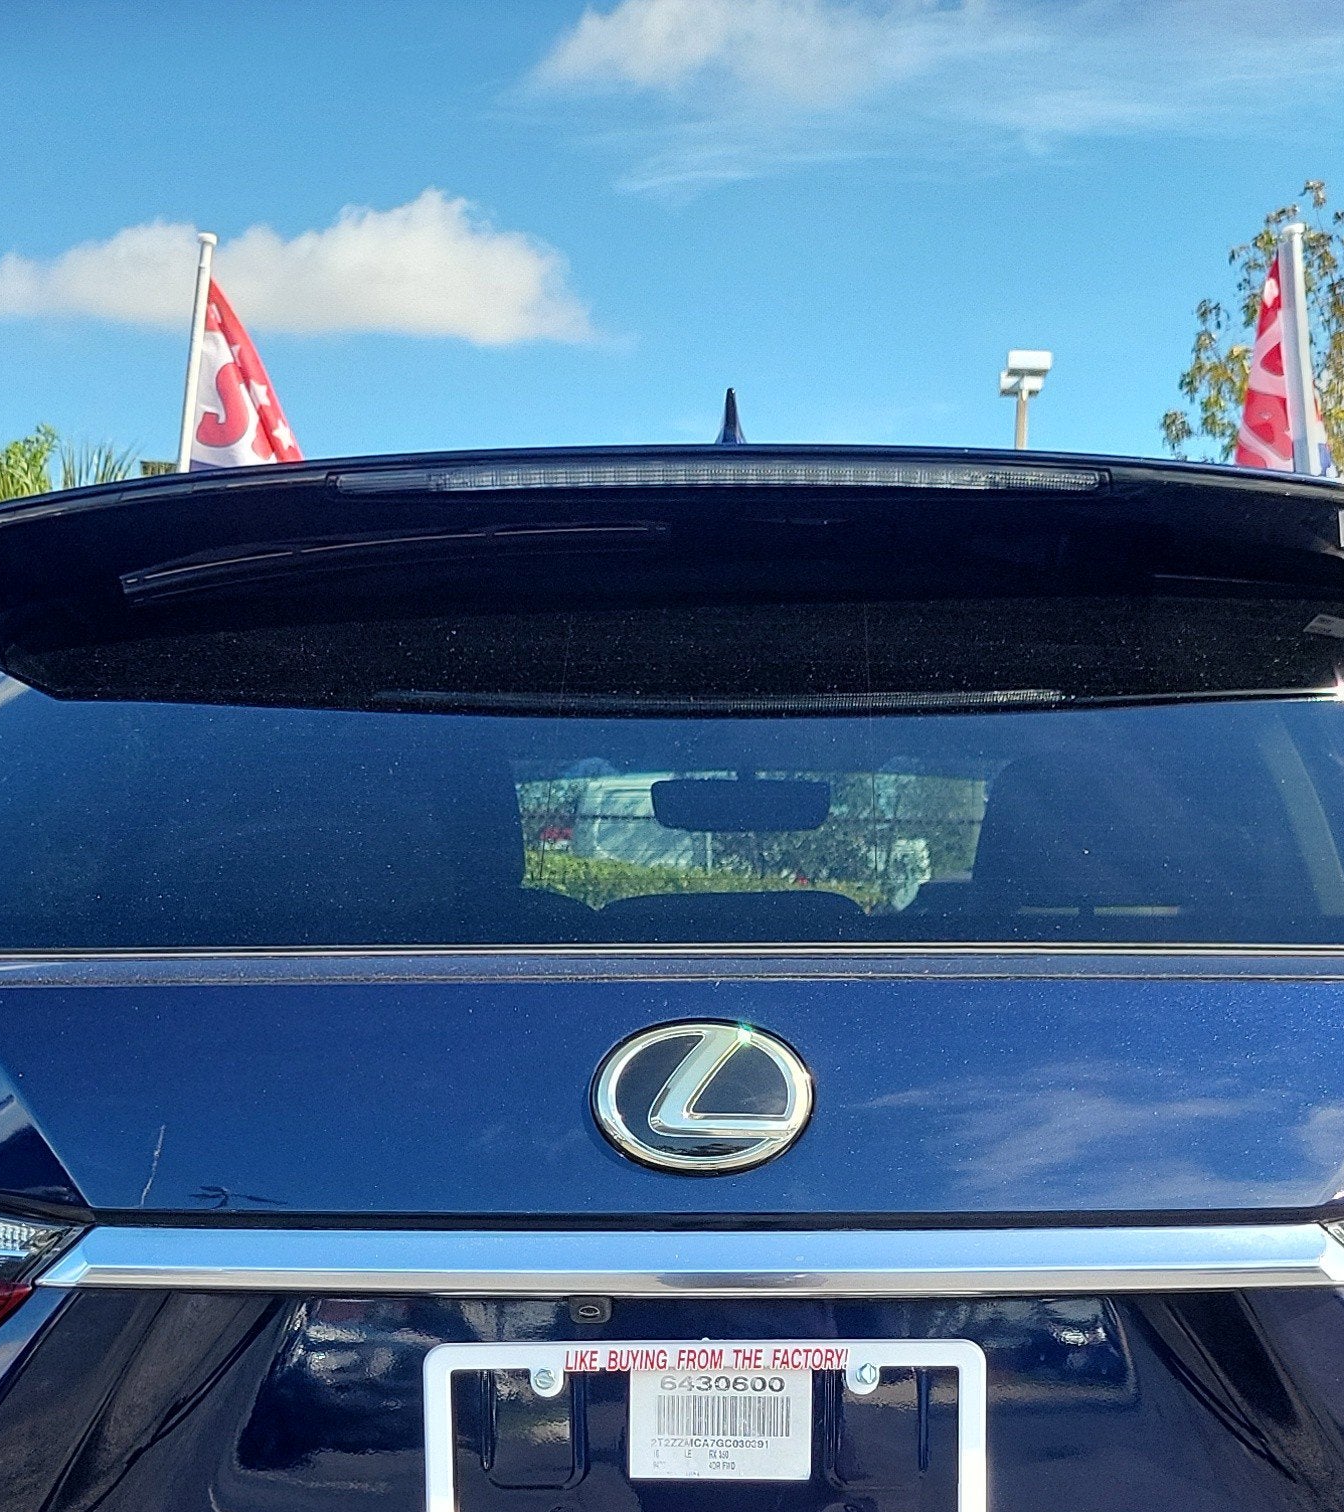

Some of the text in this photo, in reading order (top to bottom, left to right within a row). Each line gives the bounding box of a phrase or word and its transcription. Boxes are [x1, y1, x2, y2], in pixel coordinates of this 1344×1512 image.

[564, 1348, 850, 1371] LIKE BUYING FROM THE FACTORY!
[660, 1375, 786, 1392] 6430600
